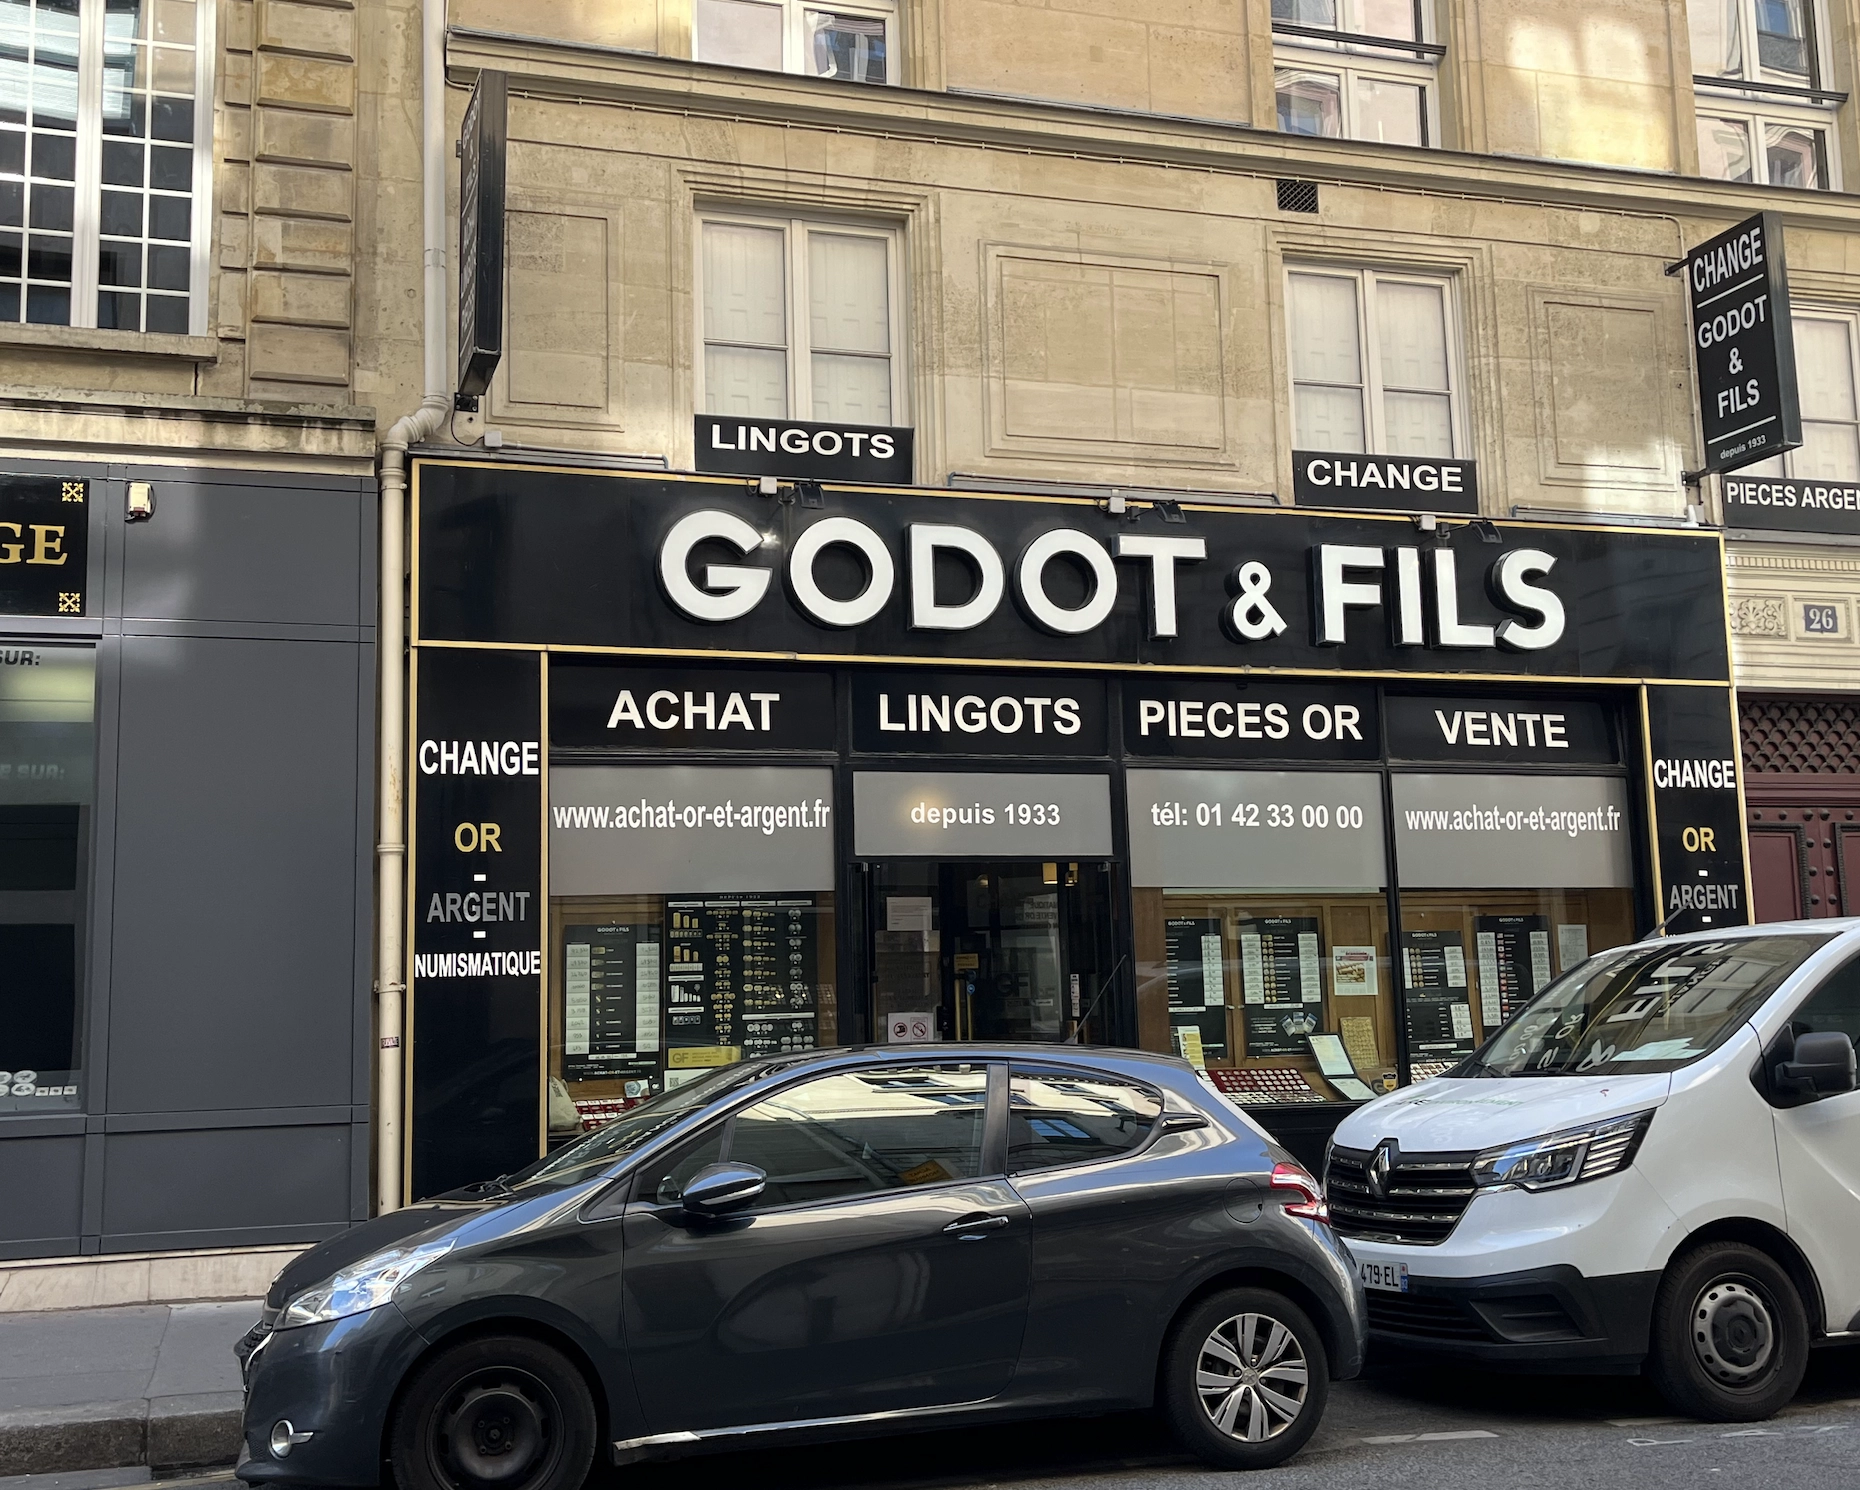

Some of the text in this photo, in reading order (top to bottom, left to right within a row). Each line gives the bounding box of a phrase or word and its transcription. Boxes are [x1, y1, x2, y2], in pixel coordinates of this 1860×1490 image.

[1693, 227, 1763, 292] CHANGE
[1698, 295, 1767, 348] GODOT
[1728, 347, 1743, 374] &
[1717, 378, 1760, 418] FILS
[711, 424, 895, 459] LINGOTS
[1720, 435, 1767, 459] depuis 1933
[1306, 459, 1464, 493] CHANGE
[1727, 482, 1797, 507] PIECES
[659, 509, 1566, 650] GODOT & FILS
[1809, 608, 1833, 630] 26
[607, 690, 780, 731] ACHAT
[880, 694, 1081, 734] LINGOTS
[1140, 700, 1363, 740] PIECES OR
[1435, 710, 1569, 748] VENTE
[419, 740, 540, 776] CHANGE
[1654, 759, 1736, 788] CHANGE
[553, 798, 831, 835] www.achat-or-et-argent.fr
[911, 802, 1060, 829] depuis 1933
[1151, 802, 1363, 829] tél: 01 42 33 00 00
[1405, 804, 1621, 837] www.achat-or-et-argent.fr
[454, 822, 502, 852] OR
[1682, 827, 1716, 852] OR
[427, 892, 530, 923] ARGENT
[1669, 884, 1738, 909] ARGENT
[414, 951, 541, 978] NUMISMATIQUE
